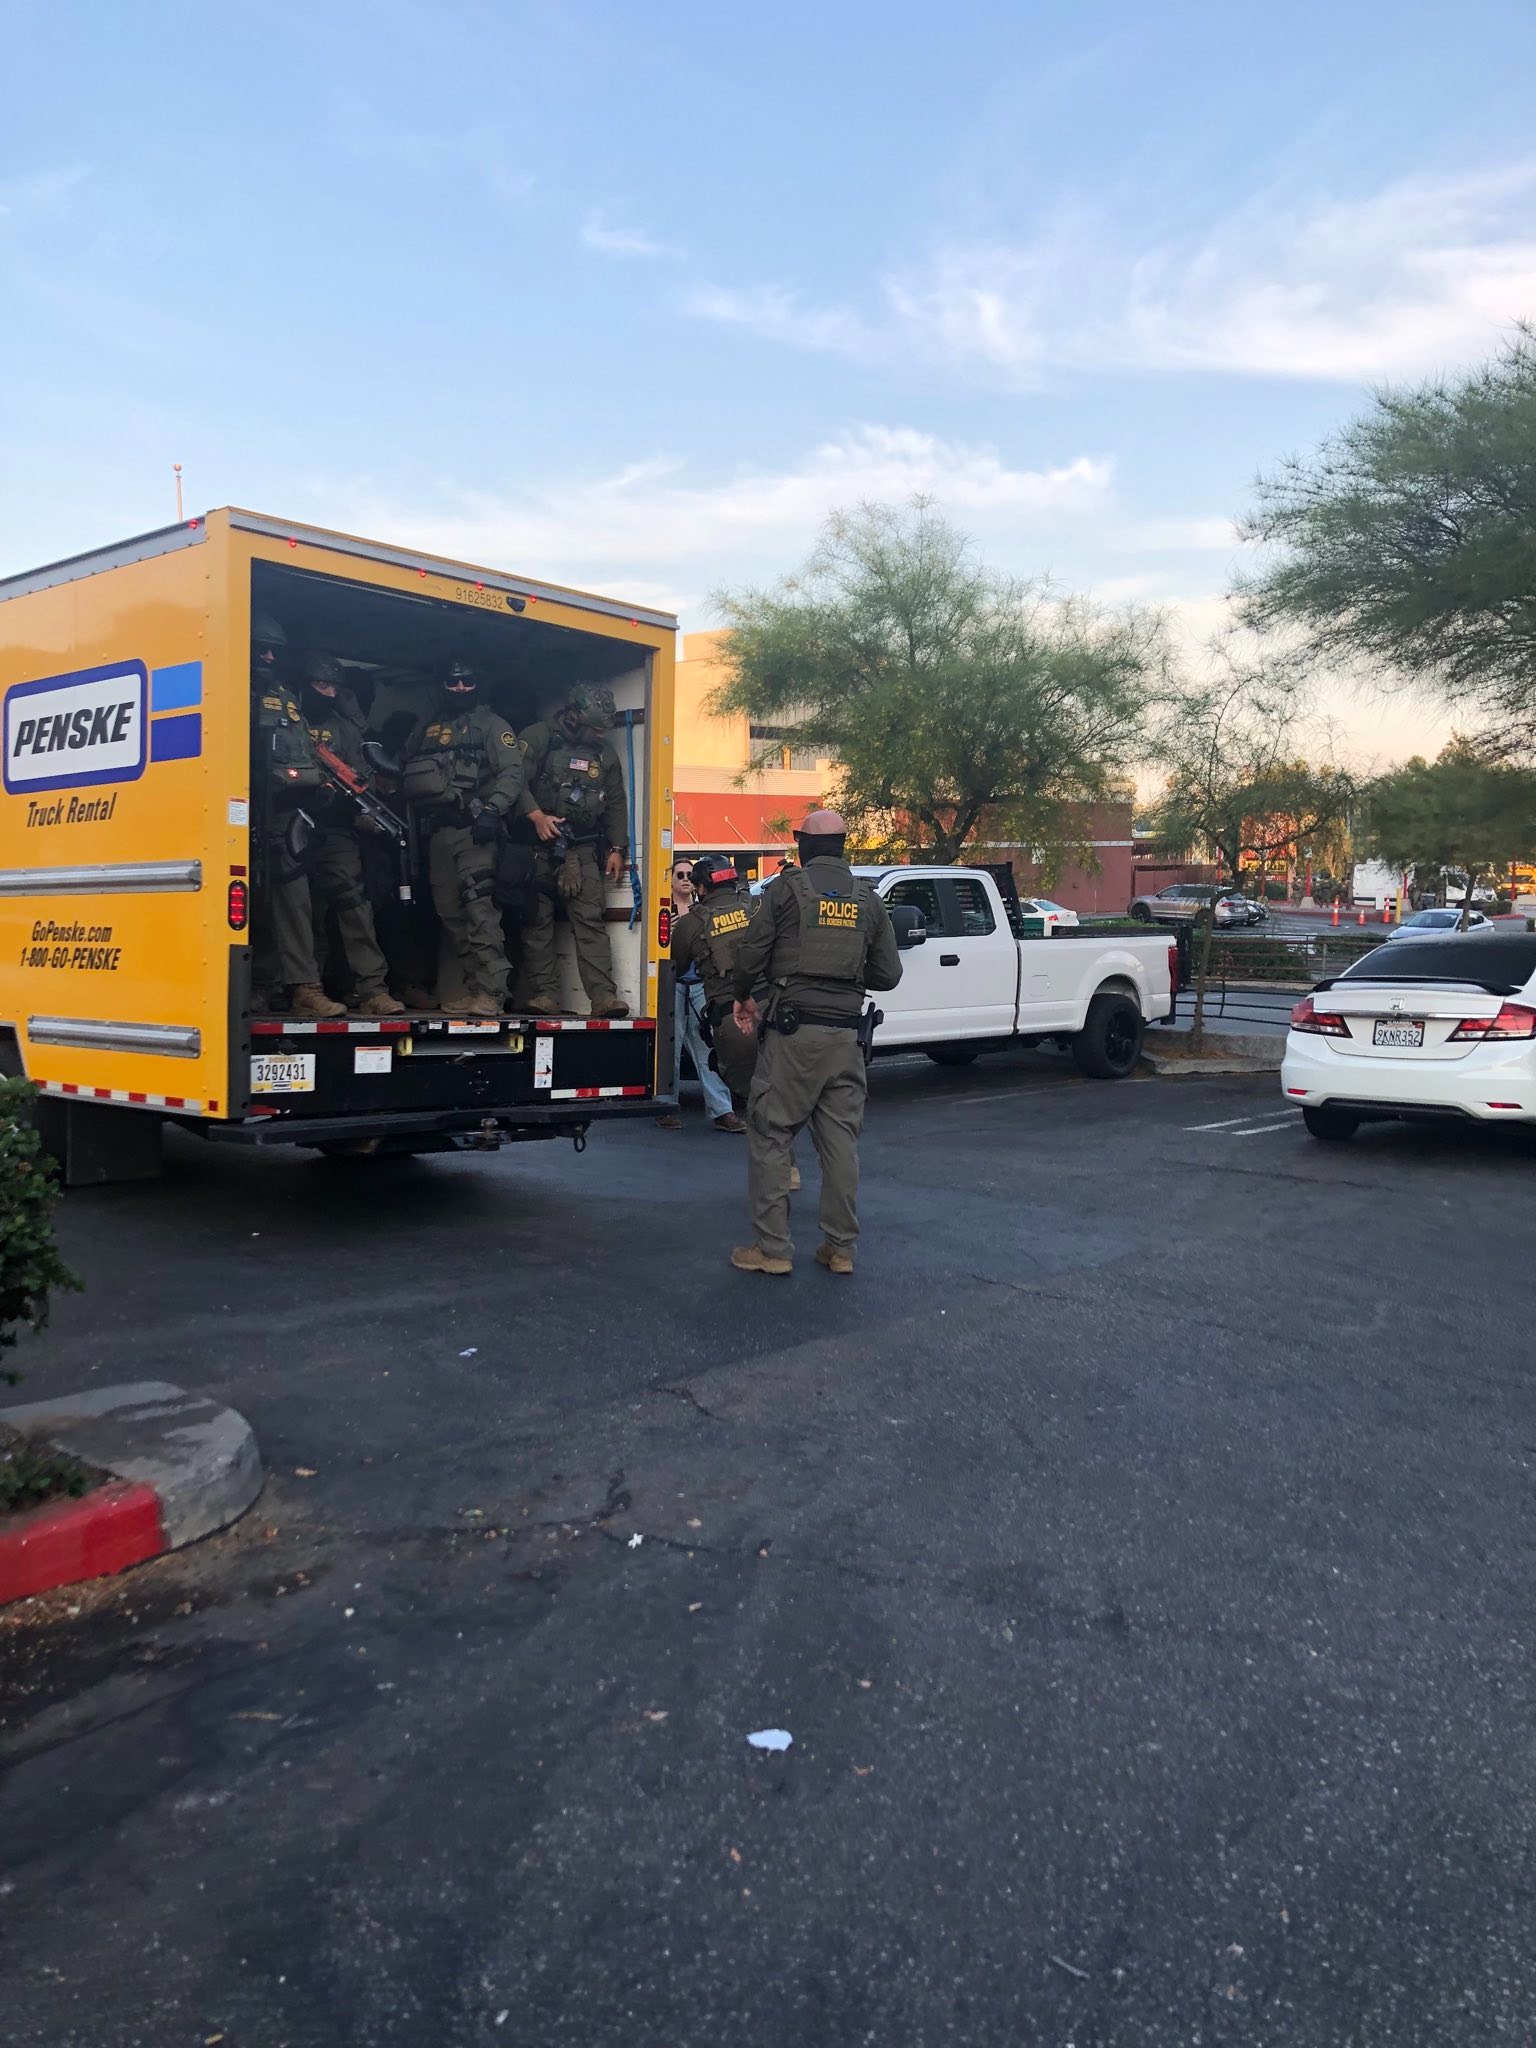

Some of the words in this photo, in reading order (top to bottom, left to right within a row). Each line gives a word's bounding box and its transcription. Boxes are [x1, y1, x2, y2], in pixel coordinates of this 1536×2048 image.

[456, 588, 503, 609] 91625832
[13, 701, 135, 758] PENSKE
[27, 798, 64, 828] Truck
[66, 792, 118, 824] Rental
[713, 910, 747, 928] POLICE
[819, 900, 858, 919] POLICE
[32, 920, 113, 942] GoPenske.com
[20, 947, 122, 971] 1-800-GO-PENSKE
[1376, 1029, 1420, 1043] 9KNR352
[257, 1064, 306, 1081] 3292431
